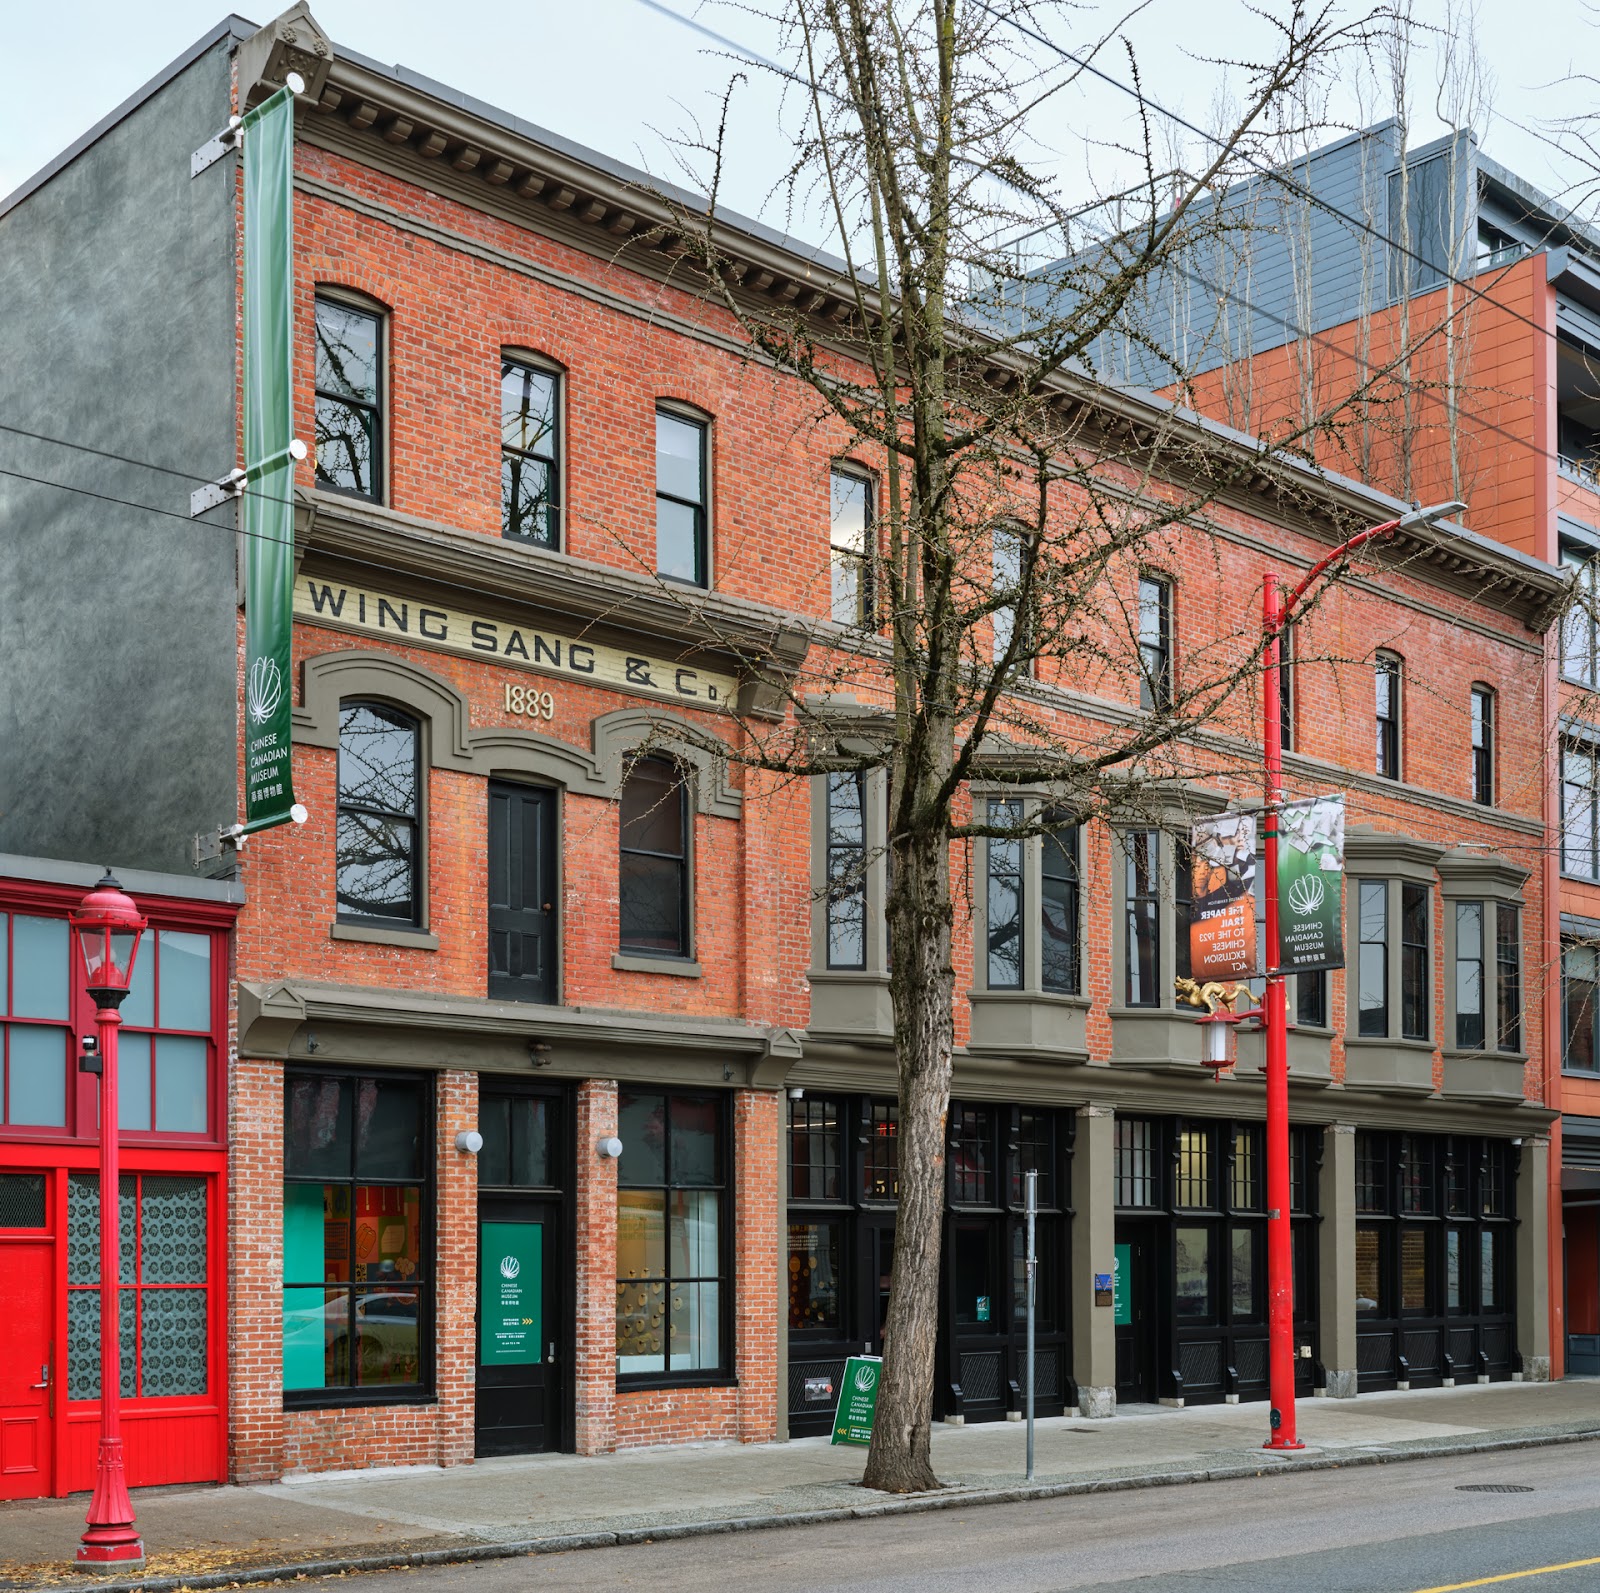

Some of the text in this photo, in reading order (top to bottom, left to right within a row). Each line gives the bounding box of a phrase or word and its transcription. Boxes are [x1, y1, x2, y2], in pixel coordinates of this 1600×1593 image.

[308, 581, 448, 641] WING
[471, 620, 595, 674] SANG
[626, 656, 659, 688] &
[504, 683, 554, 721] 1889
[250, 733, 277, 752] CHINESE
[250, 746, 288, 768] CANADIAN
[250, 766, 279, 784] MUSEUM
